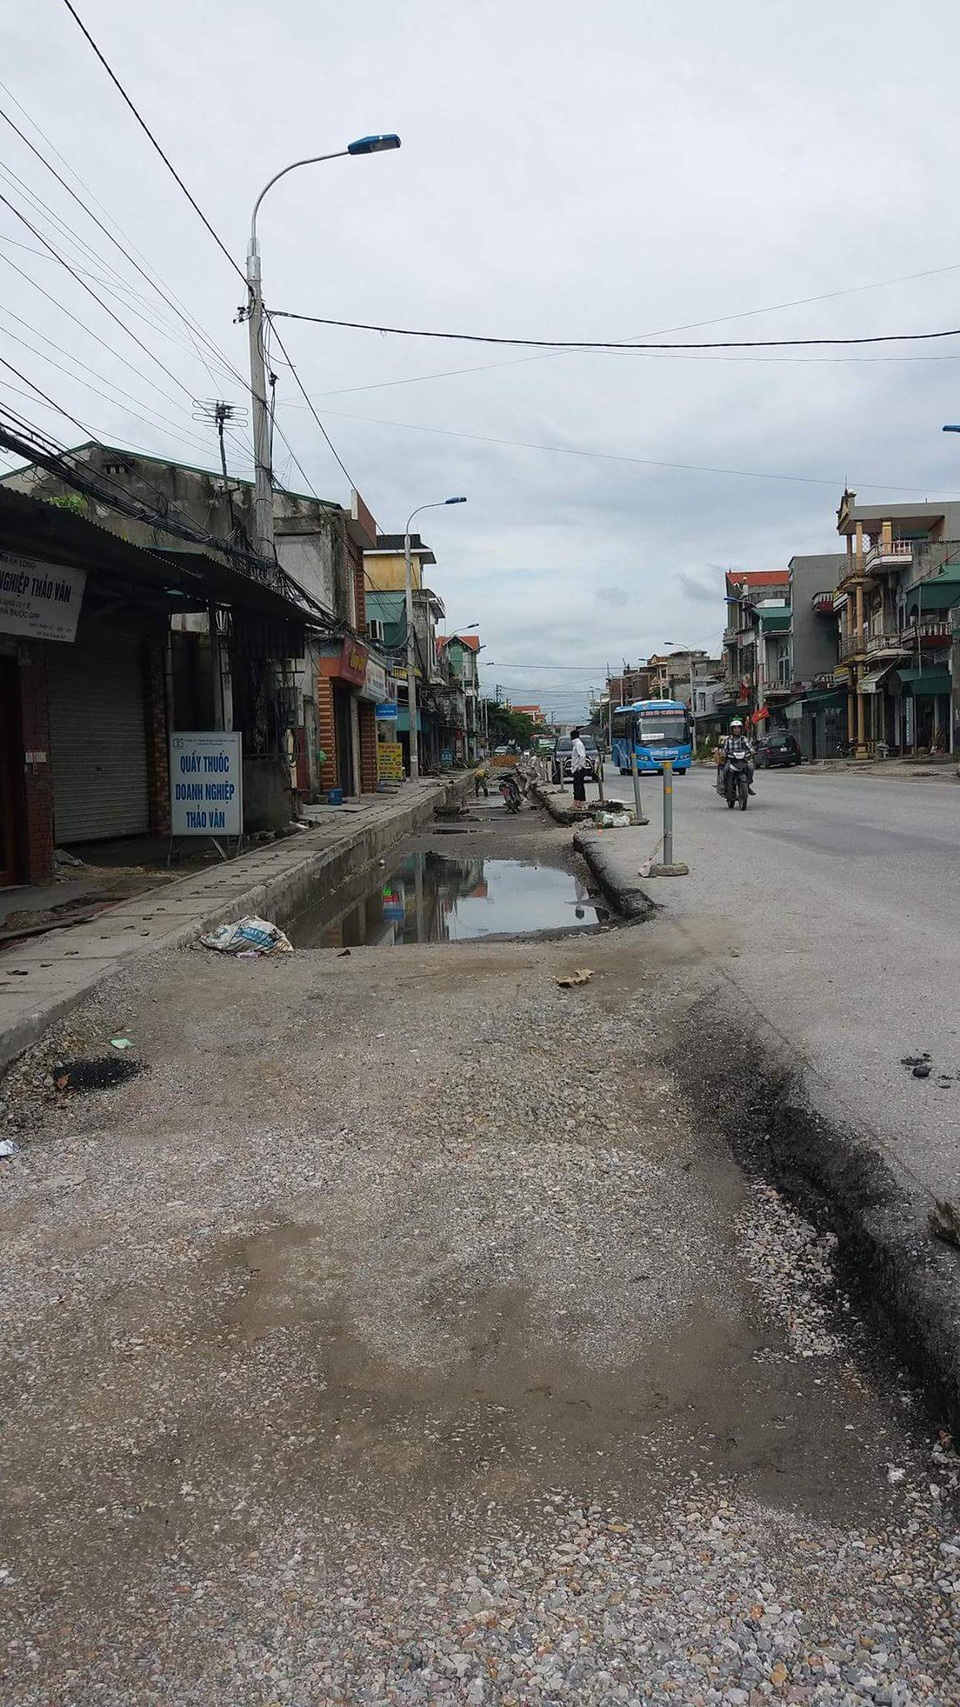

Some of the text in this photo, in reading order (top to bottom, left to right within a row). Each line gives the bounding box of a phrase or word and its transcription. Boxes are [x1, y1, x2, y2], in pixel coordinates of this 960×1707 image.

[31, 573, 53, 600] THẢO
[54, 580, 72, 603] VÂN
[203, 749, 230, 773] THUỐC
[176, 780, 235, 804] DOANH NGHIỆP
[186, 804, 225, 828] THẢO VÂN
